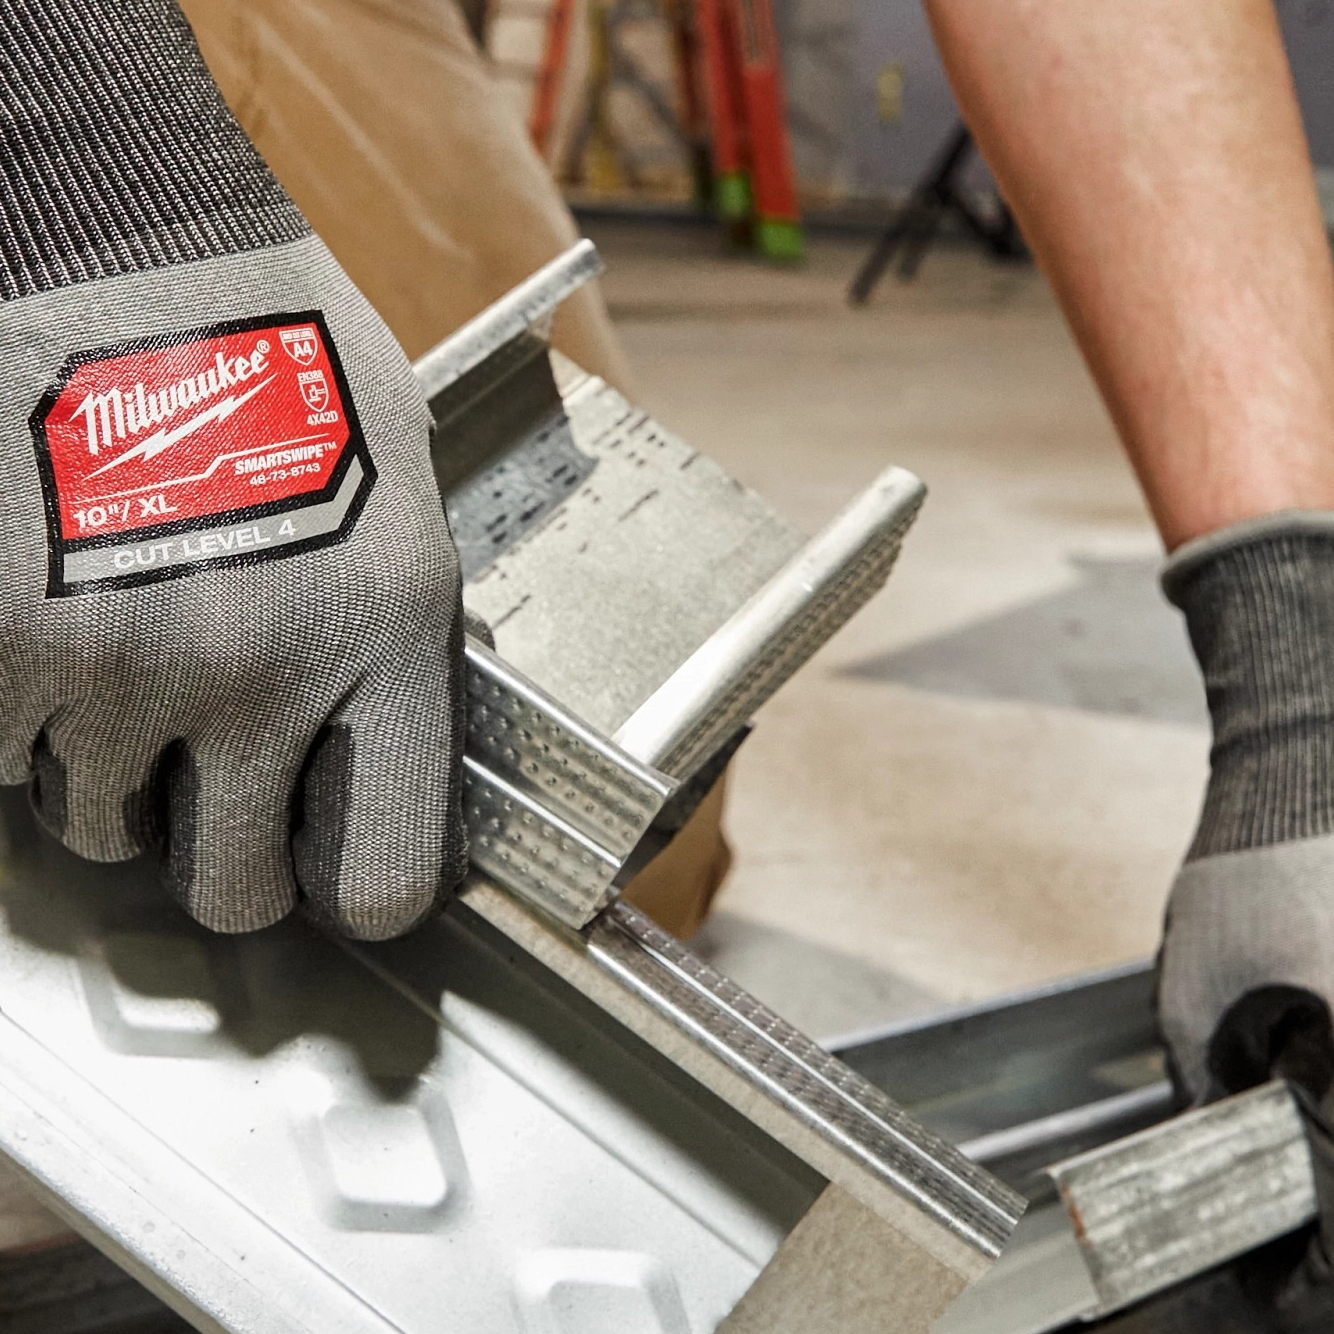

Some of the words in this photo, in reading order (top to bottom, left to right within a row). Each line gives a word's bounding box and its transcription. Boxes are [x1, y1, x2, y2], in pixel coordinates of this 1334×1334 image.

[293, 340, 314, 358] A4
[297, 369, 324, 382] EN388
[307, 410, 339, 426] 4X42D
[249, 462, 321, 485] 48-73-8743
[139, 494, 178, 517] XL
[114, 543, 175, 568] CUT
[181, 525, 271, 557] LEVEL
[278, 519, 296, 538] 4
